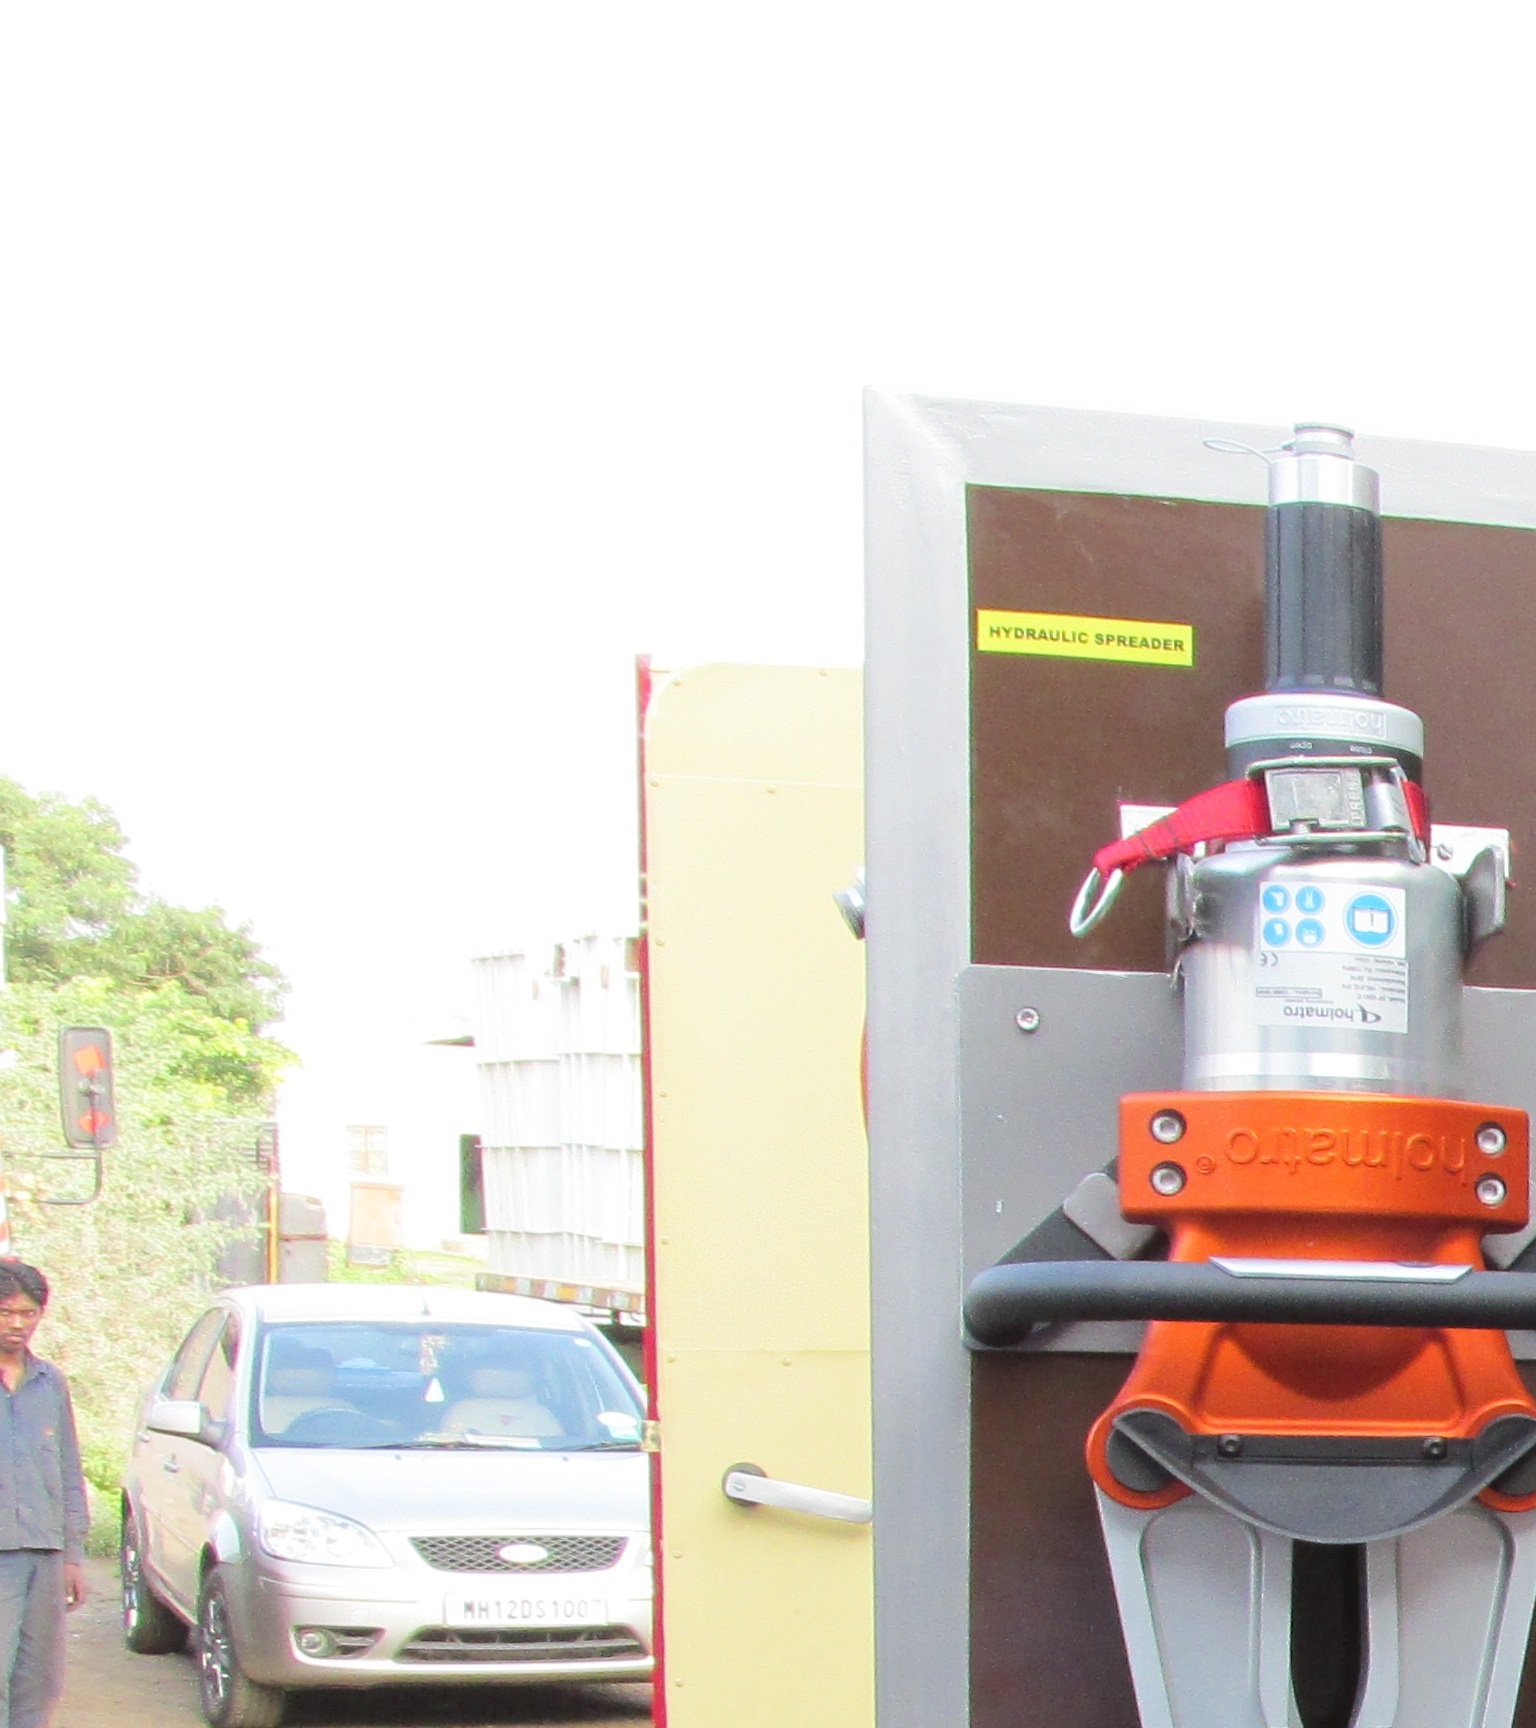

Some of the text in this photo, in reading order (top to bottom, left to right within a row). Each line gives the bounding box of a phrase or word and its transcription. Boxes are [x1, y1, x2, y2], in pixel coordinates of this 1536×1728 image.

[989, 625, 1185, 651] HYDRAULIC SPREADER
[1283, 1005, 1355, 1023] holmatro
